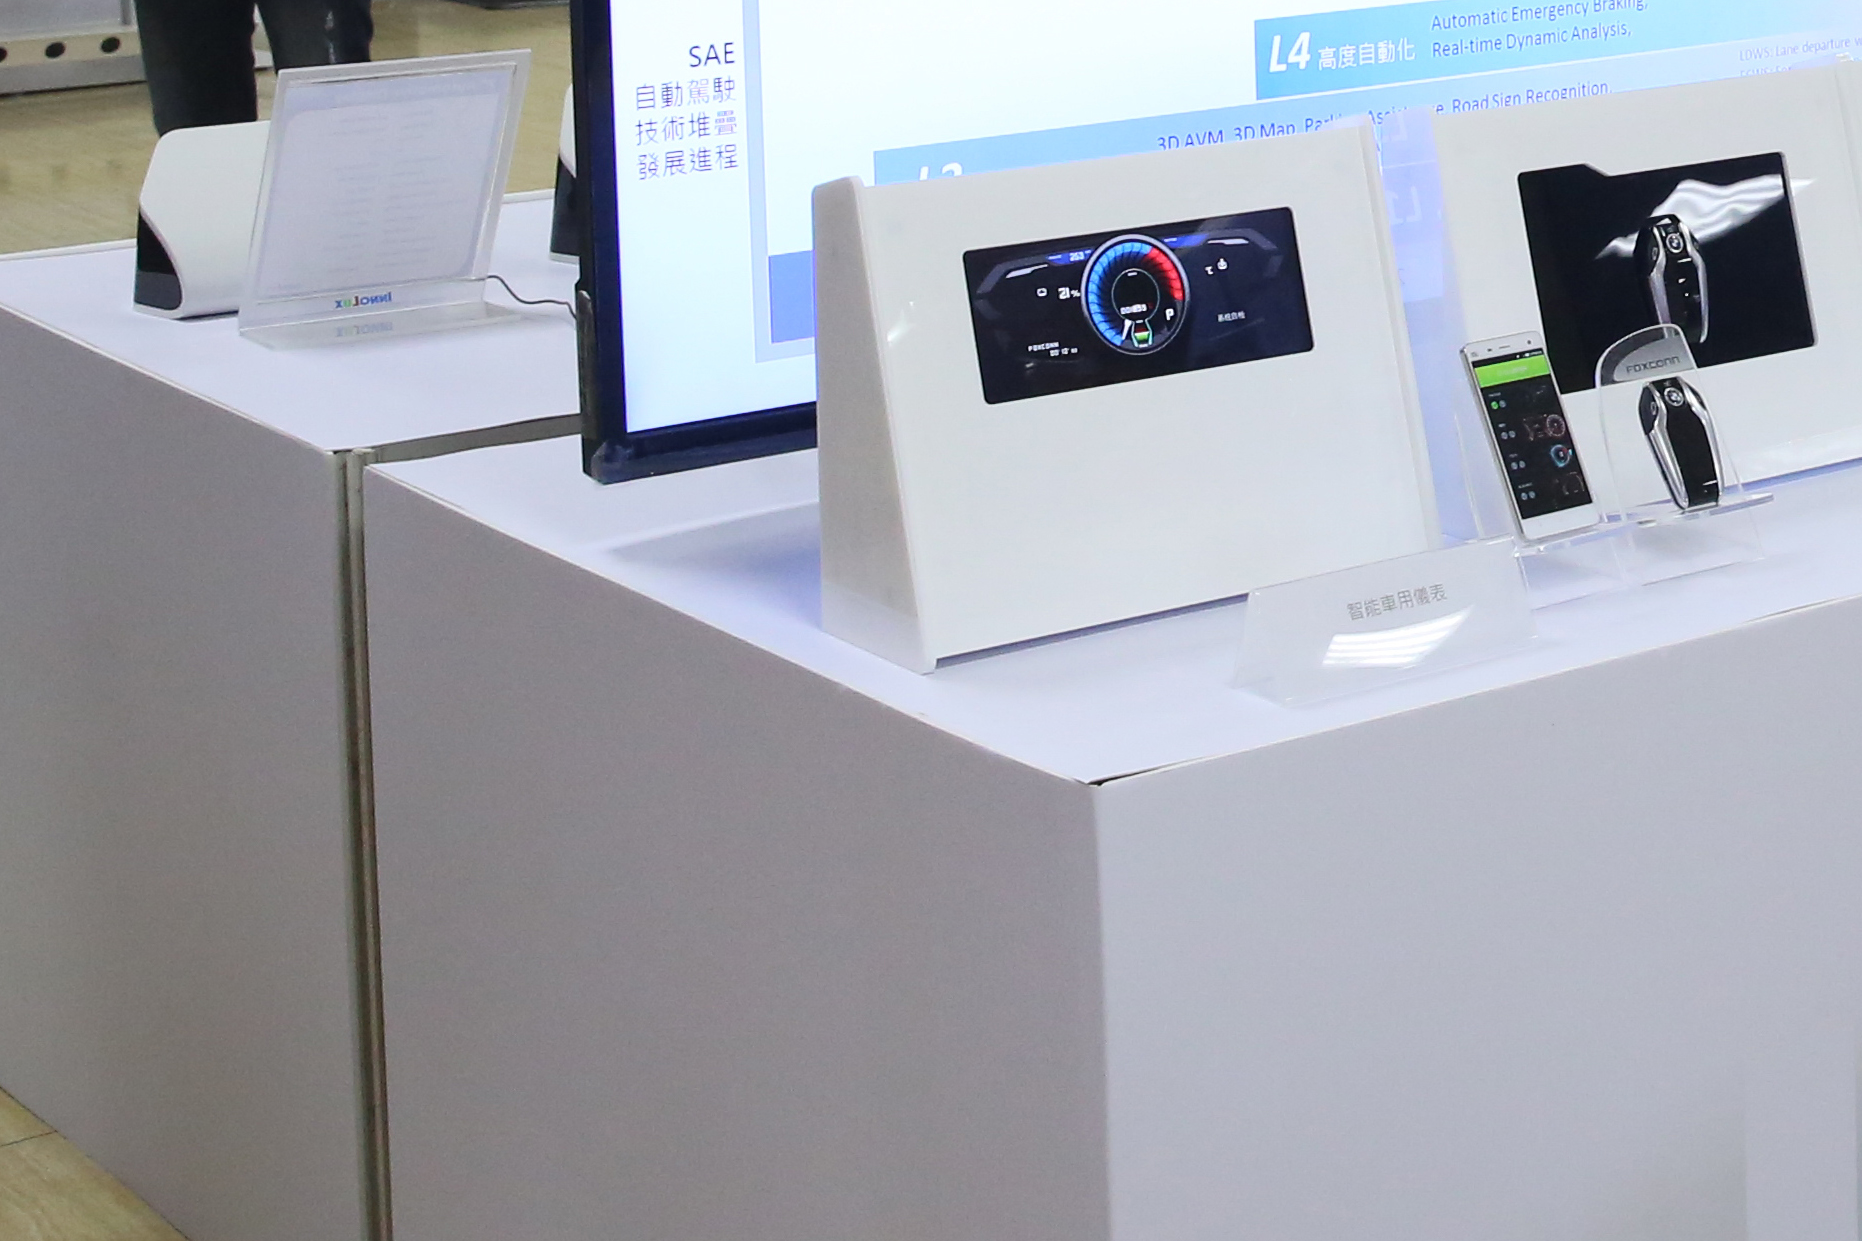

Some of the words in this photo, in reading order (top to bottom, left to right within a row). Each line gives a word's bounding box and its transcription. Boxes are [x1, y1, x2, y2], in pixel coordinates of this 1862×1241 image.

[1431, 7, 1509, 32] Automatic
[687, 41, 736, 68] SAE
[1268, 30, 1311, 74] L4
[1317, 36, 1416, 71] 高度自動化
[1432, 35, 1502, 59] Real-time
[1505, 27, 1569, 53] Dynamic
[1571, 18, 1632, 45] Analysis,
[1775, 39, 1800, 57] Lane
[1801, 34, 1852, 55] departure
[634, 75, 738, 111] 自動駕駛
[1452, 95, 1490, 115] Road
[1491, 89, 1523, 109] Sign
[634, 109, 739, 147] 技術堆疊
[637, 143, 741, 182] 發展進程
[1626, 355, 1681, 374] FOXCONN
[1346, 582, 1449, 622] 智能車用儀表
